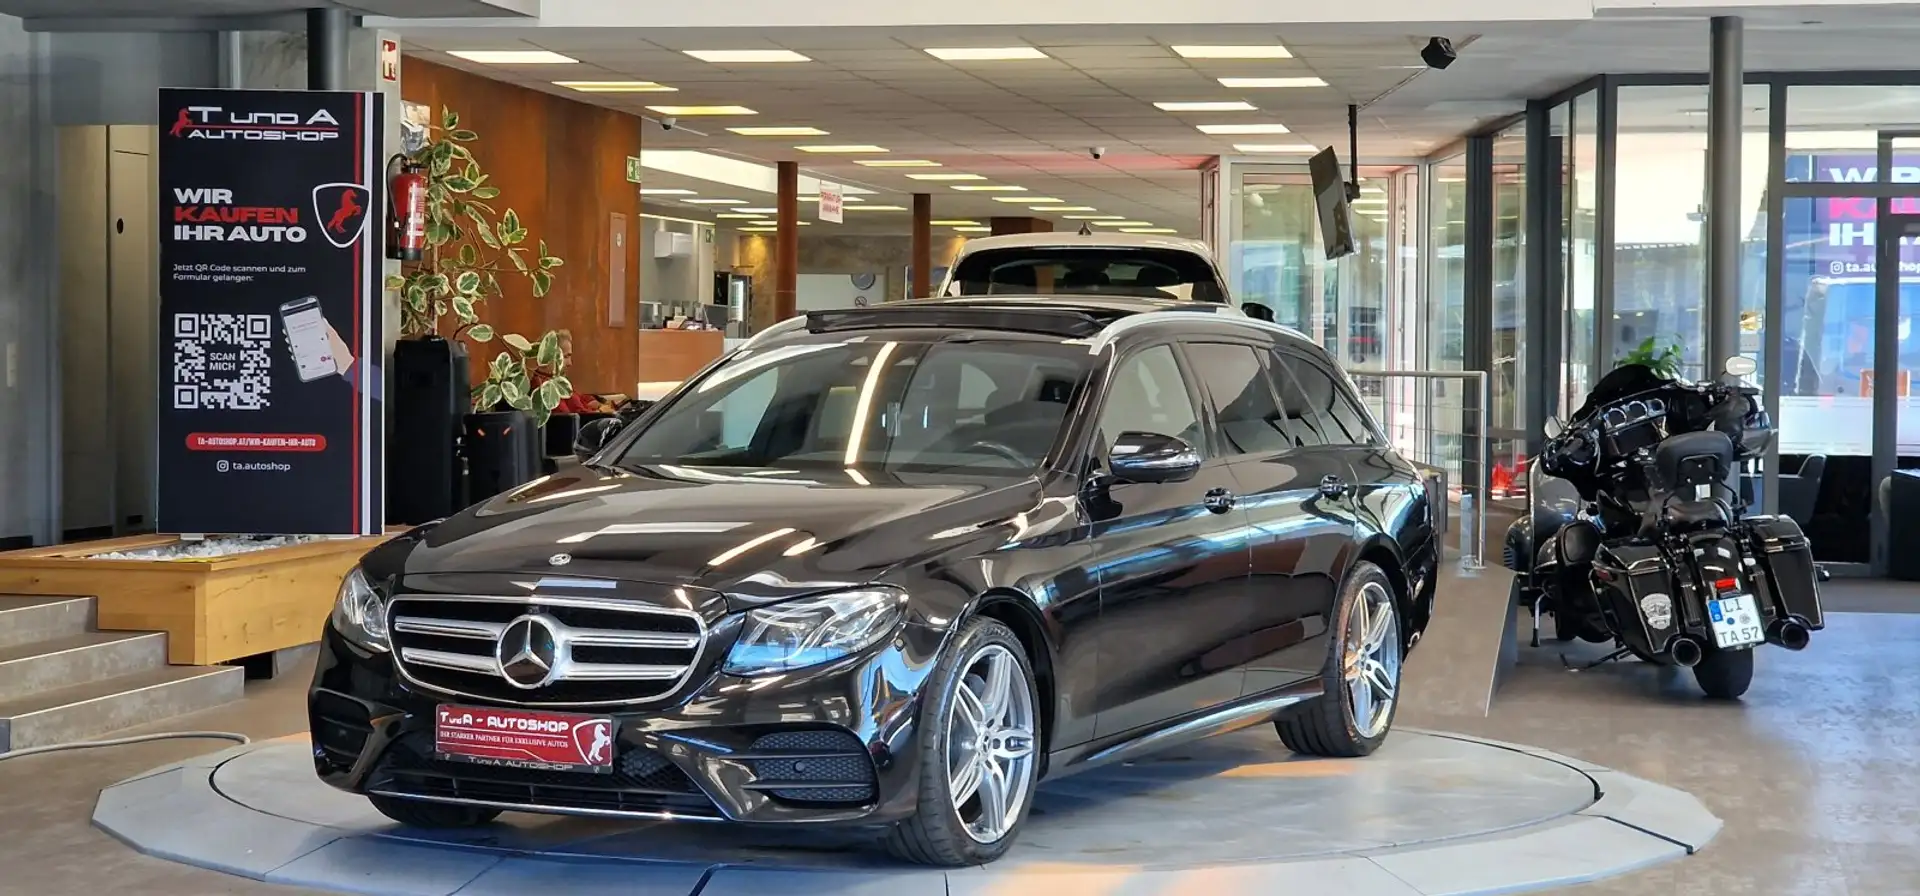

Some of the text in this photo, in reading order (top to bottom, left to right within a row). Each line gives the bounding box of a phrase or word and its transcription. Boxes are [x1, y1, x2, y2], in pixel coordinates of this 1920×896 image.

[188, 106, 222, 123] T
[306, 108, 339, 125] A
[188, 129, 339, 141] AUTOSHOP
[173, 188, 233, 204] WIR
[174, 206, 299, 223] KAUFEN
[174, 225, 308, 243] IHR AUTO
[195, 264, 208, 272] QR
[210, 264, 232, 272] Code
[269, 265, 286, 273] und
[173, 273, 254, 283] Formular gelangen:
[210, 352, 236, 361] SCAN
[209, 362, 236, 371] MICH
[232, 462, 291, 472] ta.autoshop
[1723, 599, 1743, 613] LI
[1719, 626, 1759, 644] TA 57
[487, 716, 569, 732] AUTOSHOP
[475, 734, 501, 742] PARTNER
[505, 761, 573, 771] AUTOSHOP
